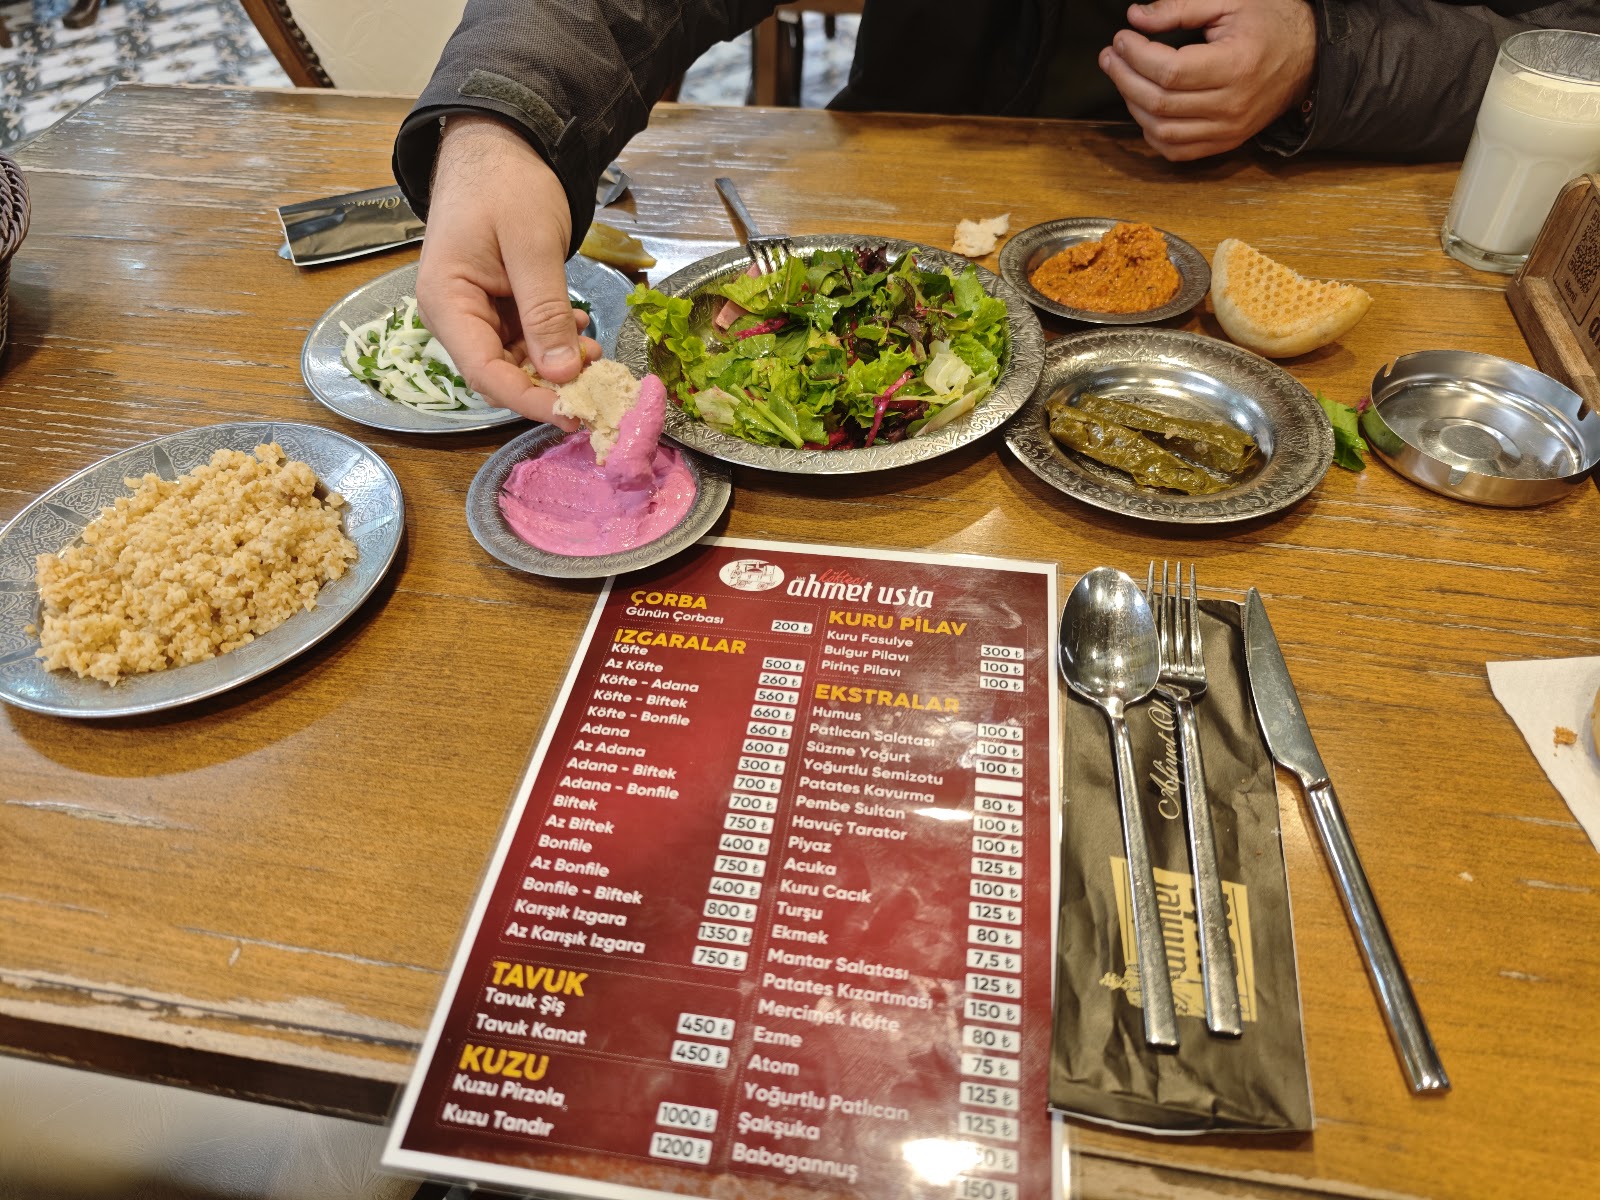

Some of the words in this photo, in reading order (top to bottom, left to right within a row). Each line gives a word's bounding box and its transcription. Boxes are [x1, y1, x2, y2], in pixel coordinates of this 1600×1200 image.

[630, 590, 707, 609] ÇORBA
[787, 573, 873, 602] ahmet
[877, 585, 934, 608] usta
[625, 606, 669, 618] Günün
[672, 610, 723, 624] Çorbası
[828, 610, 893, 628] KURU
[900, 615, 967, 637] PİLAV
[773, 621, 799, 631] 200
[614, 628, 747, 654] IZGARALAR
[826, 630, 857, 641] Kuru
[861, 633, 913, 648] Fasulye
[611, 642, 648, 655] Köfte
[824, 644, 868, 658] Bulgur
[871, 649, 909, 662] Pilavı
[983, 646, 1010, 657] 300
[604, 658, 623, 668] Az
[625, 659, 663, 672] Köfte
[765, 659, 791, 670] 500
[821, 659, 859, 674] Pirinç
[862, 663, 900, 676] Pilavı
[983, 662, 1008, 673] 100
[599, 673, 637, 686] Köfte
[650, 678, 699, 692] Adana
[761, 674, 787, 686] 260
[983, 678, 1008, 689] 100
[593, 689, 632, 702] Köfte
[646, 694, 687, 708] Biftek
[758, 690, 784, 702] 560
[815, 683, 960, 713] EKSTRALAR
[587, 705, 626, 719] Köfte
[640, 710, 690, 726] Bonfile
[753, 707, 780, 718] 660
[812, 705, 861, 721] Humus
[580, 722, 630, 737] Adana
[749, 724, 777, 736] 660
[809, 722, 869, 741] Patlıcan
[874, 730, 935, 747] Salatası
[982, 725, 1007, 737] 100
[573, 739, 593, 751] Az
[594, 741, 646, 757] Adana
[745, 741, 774, 753] 600
[806, 740, 855, 756] Süzme
[859, 746, 910, 763] Yoğurt
[981, 743, 1007, 756] 100
[566, 756, 618, 773] Adana
[632, 763, 676, 779] Biftek
[741, 758, 770, 771] 300
[803, 757, 868, 776] Yoğurtlu
[871, 766, 943, 785] Semizotu
[980, 761, 1006, 774] 100
[559, 775, 611, 792] Adana
[626, 782, 679, 799] Bonfile
[737, 778, 765, 789] 700
[799, 776, 860, 794] Patates
[863, 783, 934, 802] Kavurma
[552, 794, 598, 810] Biftek
[733, 797, 761, 809] 700
[795, 794, 850, 812] Pembe
[854, 801, 905, 819] Sultan
[982, 798, 1002, 811] 80
[544, 814, 566, 828] Az
[568, 816, 614, 834] Biftek
[729, 815, 756, 829] 750
[791, 814, 843, 835] Havuç
[846, 821, 907, 840] Tarator
[979, 818, 1006, 832] 100
[538, 834, 592, 852] Bonfile
[721, 837, 754, 851] 400
[788, 835, 831, 853] Piyaz
[977, 838, 1005, 852] 100
[529, 855, 551, 870] Az
[553, 857, 609, 877] Bonfile
[719, 858, 748, 872] 750
[783, 857, 836, 875] Acuka
[977, 860, 1003, 873] 125
[522, 876, 578, 896] Bonfile
[593, 885, 642, 904] Biftek
[712, 880, 744, 894] 400
[779, 878, 819, 896] Kuru
[822, 884, 872, 903] Cacık
[975, 882, 1004, 896] 100
[514, 898, 570, 920] Karışık
[572, 906, 627, 926] Izgara
[706, 902, 739, 917] 800
[776, 900, 823, 921] Turşu
[976, 904, 1002, 919] 125
[505, 921, 528, 938] Az
[530, 924, 587, 947] Karışık
[589, 932, 645, 953] Izgara
[700, 924, 737, 941] 1350
[771, 924, 828, 944] Ekmek
[976, 928, 998, 942] 80
[698, 948, 728, 965] 750
[766, 948, 833, 969] Mantar
[835, 956, 908, 979] Salatası
[974, 951, 999, 968] 7,5
[492, 961, 588, 997] TAVUK
[972, 976, 1000, 992] 125
[762, 972, 833, 997] Patates
[837, 982, 932, 1009] Kızartması
[485, 986, 537, 1009] Tavuk
[539, 994, 565, 1017] Şiş
[970, 1001, 1000, 1019] 150
[476, 1012, 528, 1035] Tavuk
[530, 1021, 587, 1044] Kanat
[682, 1016, 715, 1034] 450
[850, 1012, 899, 1032] Köfte
[752, 1025, 802, 1047] Ezme
[972, 1028, 996, 1046] 80
[676, 1044, 710, 1062] 450
[459, 1044, 549, 1081] KUZU
[747, 1054, 799, 1076] Atom
[973, 1057, 993, 1075] 75
[452, 1073, 498, 1096] Kuzu
[500, 1080, 564, 1106] Pirzola
[967, 1085, 996, 1104] 125
[744, 1082, 825, 1110] Yoğurtlu
[829, 1094, 909, 1121] Patlıcan
[442, 1102, 489, 1126] Kuzu
[493, 1110, 554, 1136] Tandır
[662, 1106, 700, 1126] 1000
[737, 1111, 819, 1139] Şakşuka
[965, 1114, 996, 1135] 125
[656, 1136, 693, 1157] 1200
[731, 1142, 859, 1184] Babagannuş
